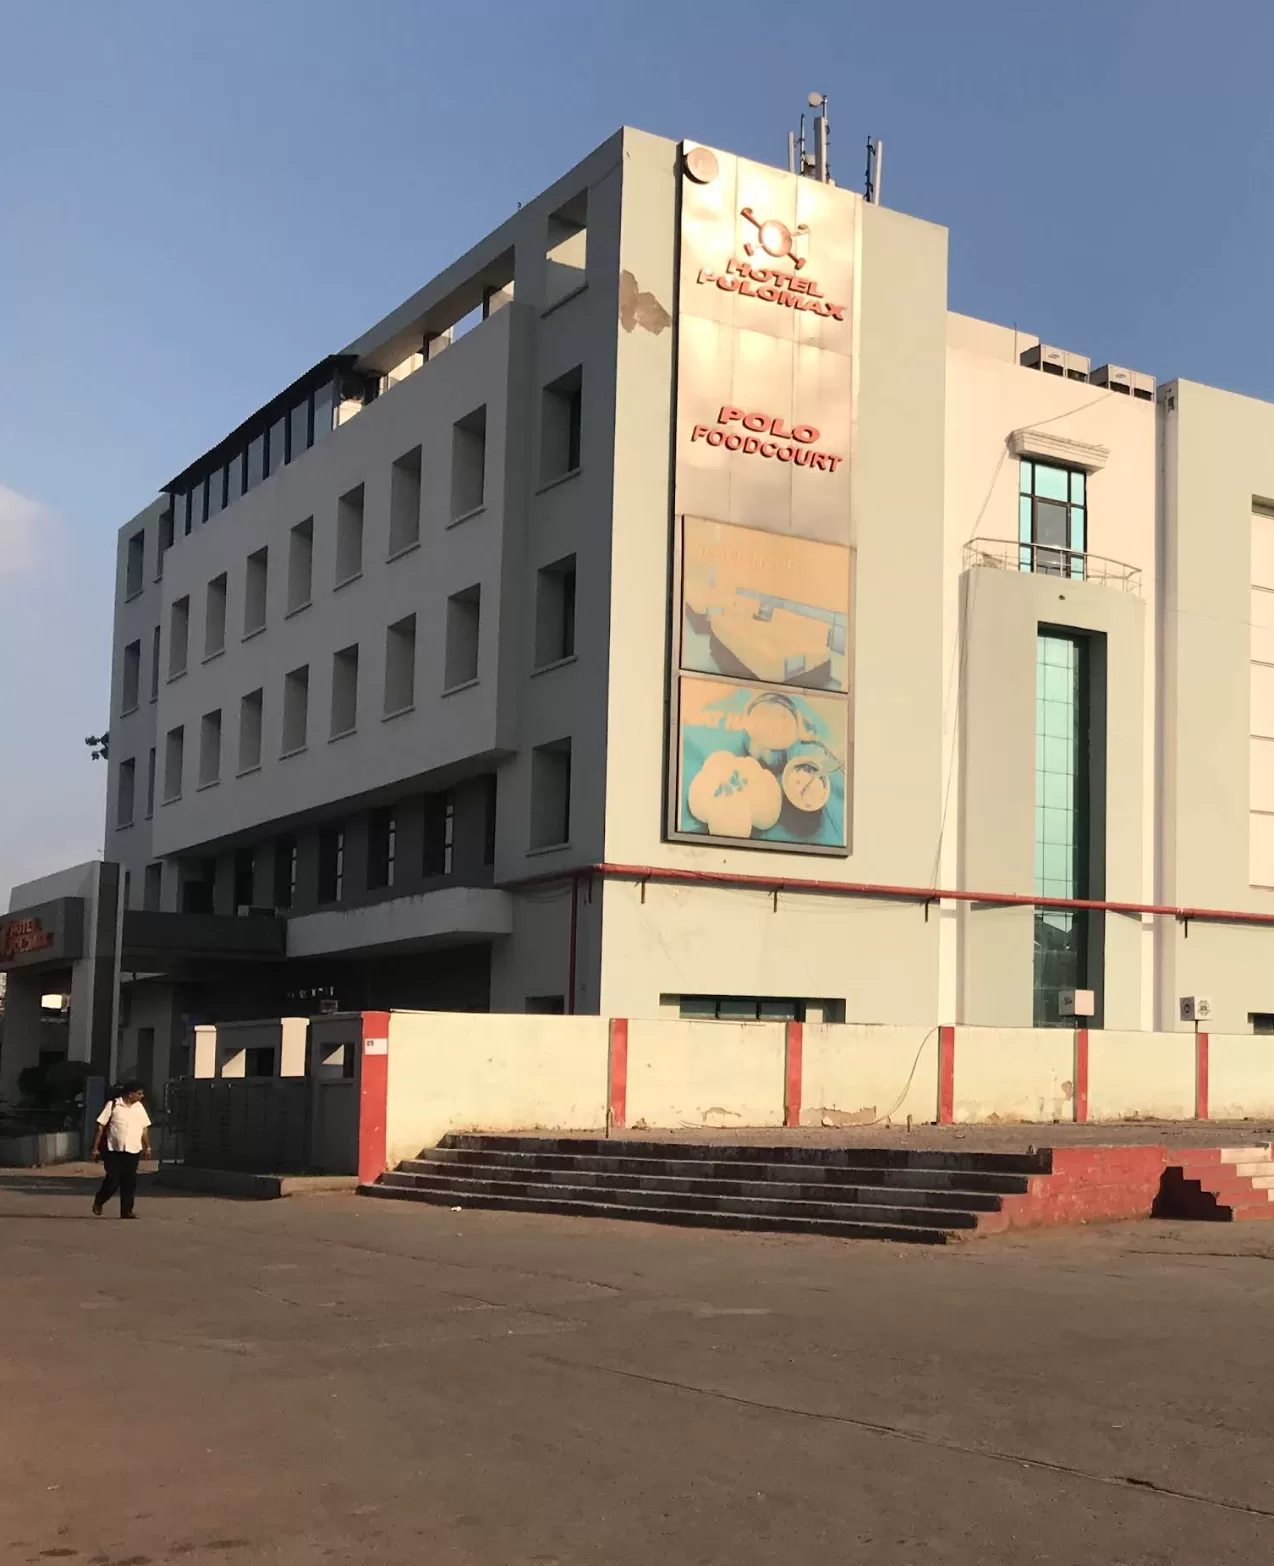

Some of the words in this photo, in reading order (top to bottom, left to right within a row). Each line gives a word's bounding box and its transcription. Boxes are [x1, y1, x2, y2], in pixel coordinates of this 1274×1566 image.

[696, 267, 845, 321] POLOMAX
[726, 259, 824, 298] HOTEL
[716, 406, 820, 444] POLO
[690, 425, 843, 472] FOODCOURT
